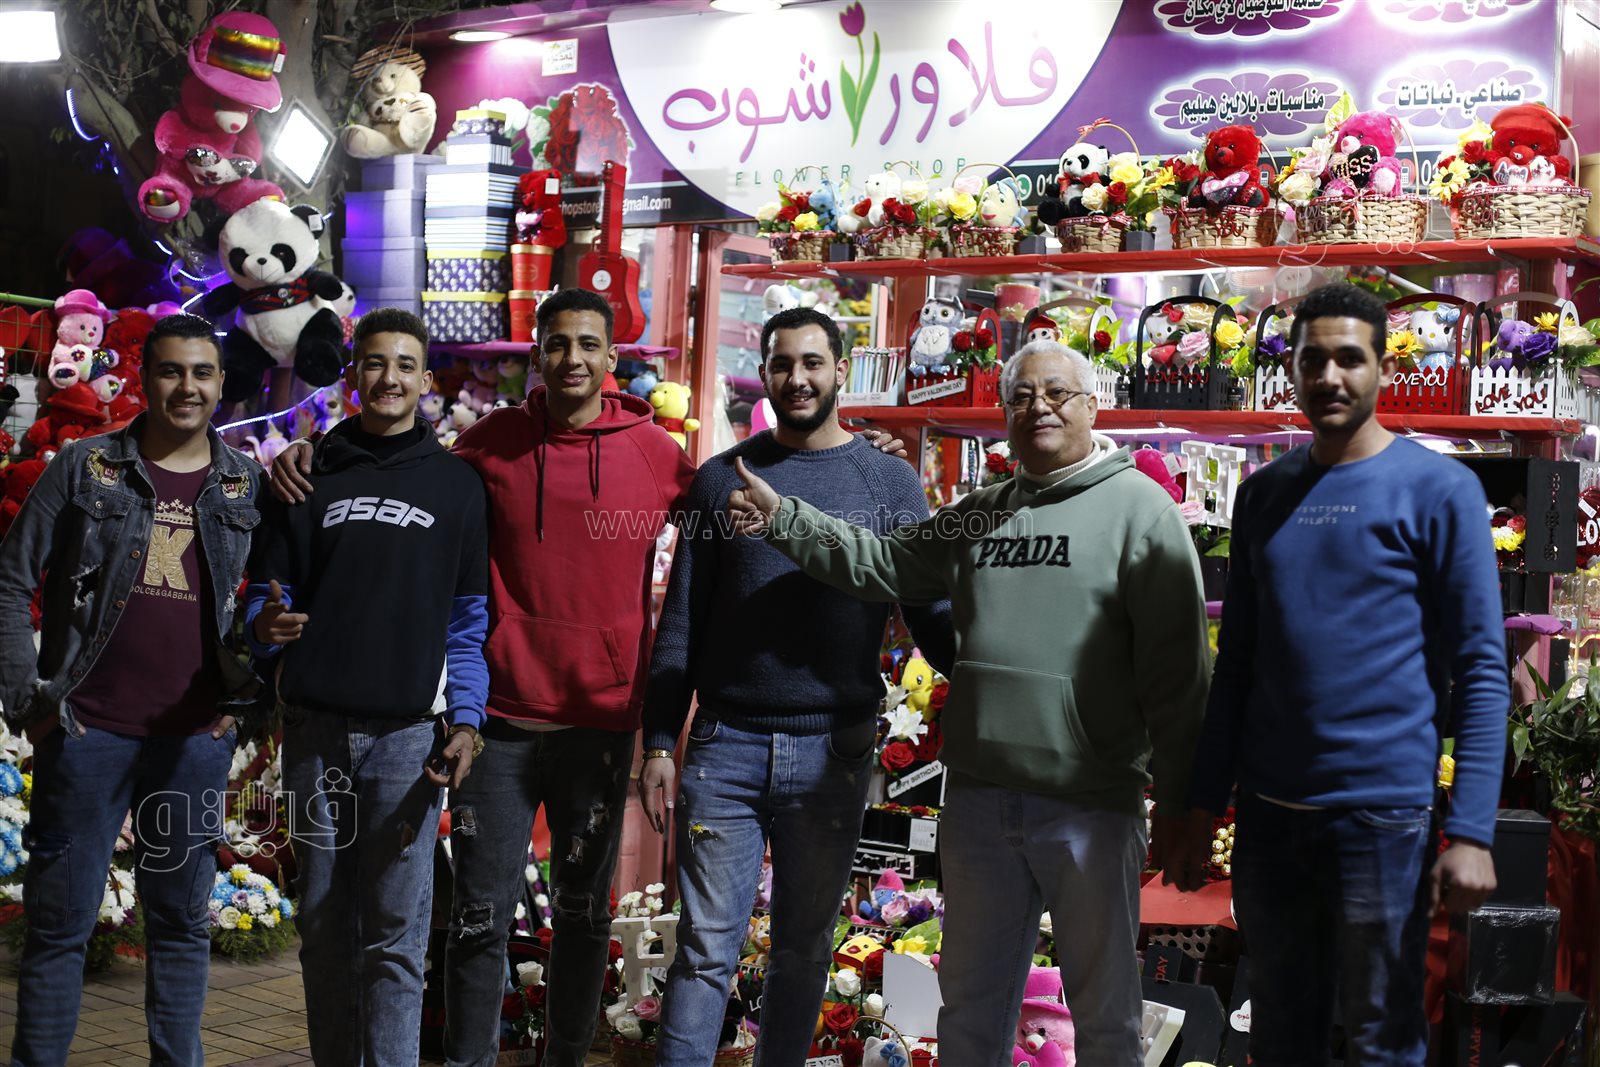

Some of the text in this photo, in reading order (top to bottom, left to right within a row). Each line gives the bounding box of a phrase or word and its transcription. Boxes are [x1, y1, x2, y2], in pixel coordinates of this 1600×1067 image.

[662, 52, 832, 163] شوب
[735, 157, 967, 186] FLOWER SHOP
[1389, 372, 1419, 387] OVE
[1475, 385, 1548, 414] LOVE YOU
[975, 534, 1073, 569] PRADA
